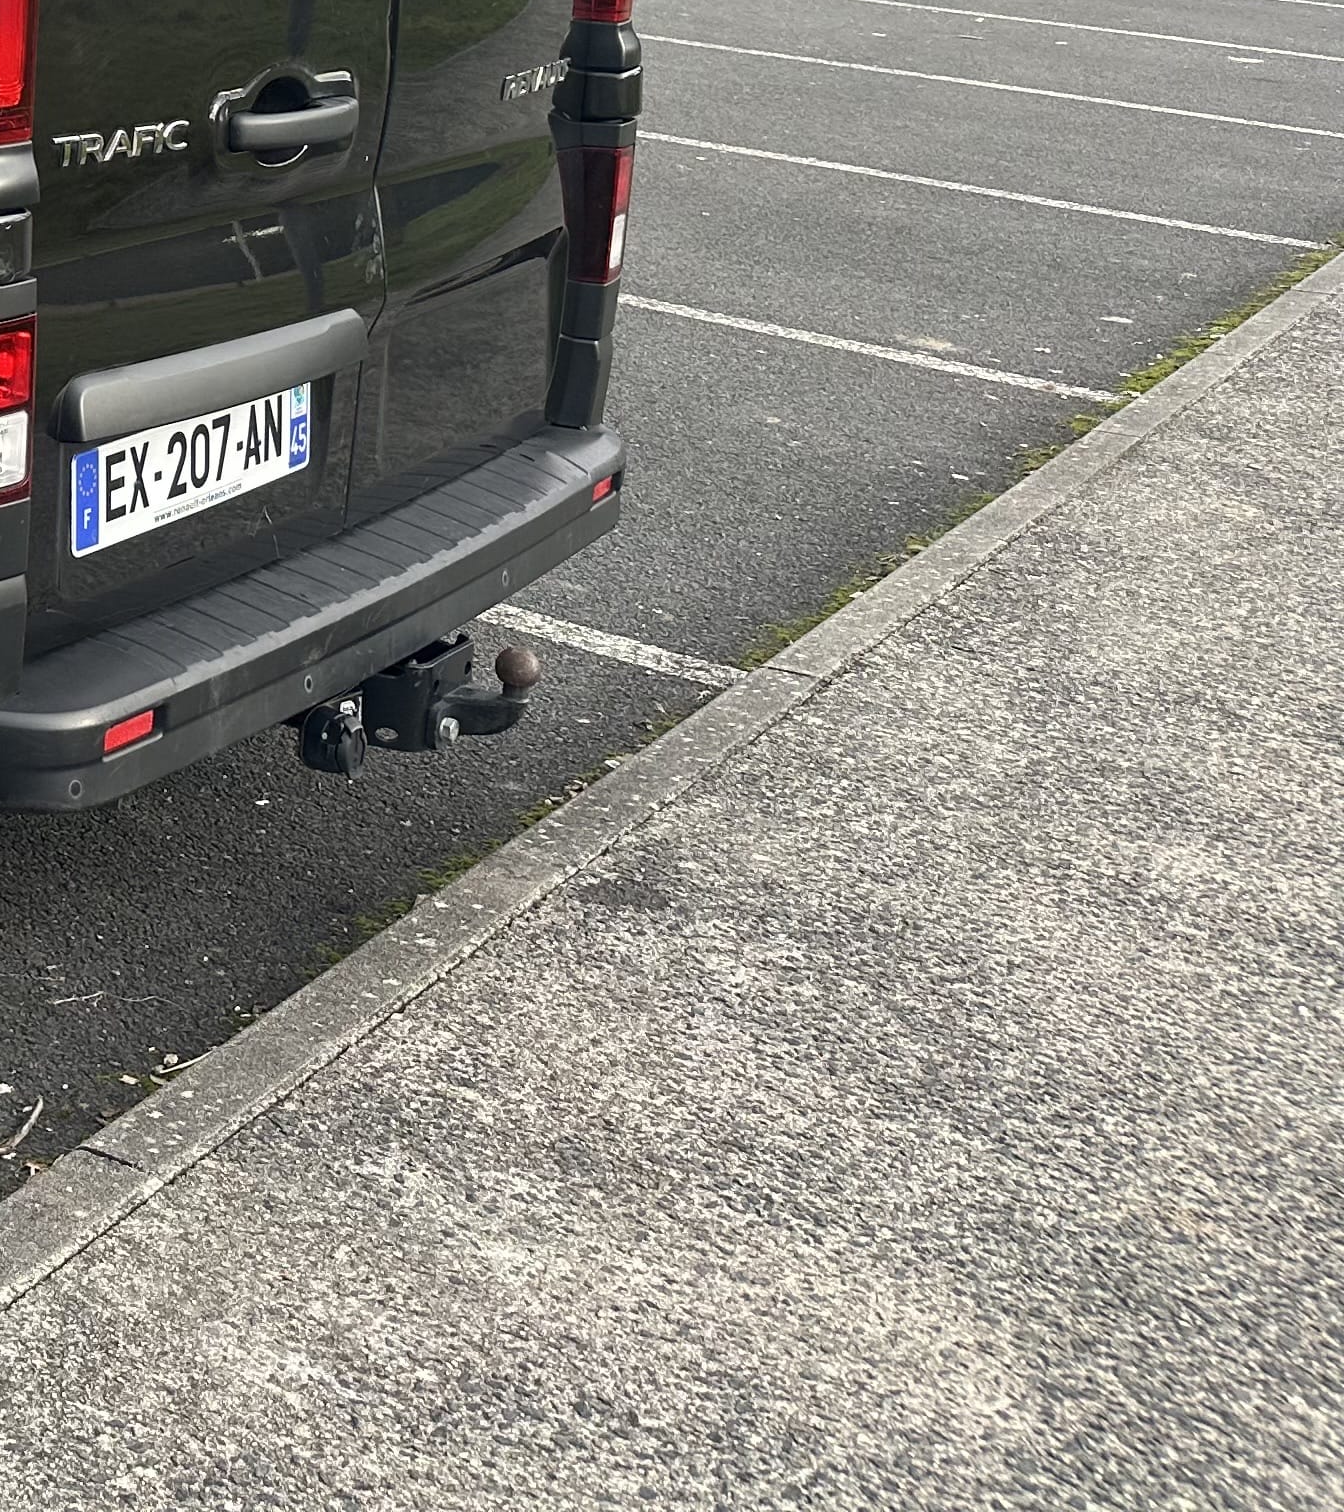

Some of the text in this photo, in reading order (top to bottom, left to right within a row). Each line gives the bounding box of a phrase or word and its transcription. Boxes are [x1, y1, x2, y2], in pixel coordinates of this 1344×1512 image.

[52, 119, 190, 168] TRAFIC
[105, 394, 283, 523] EX-207-AN
[291, 421, 307, 455] 45
[83, 507, 92, 530] F
